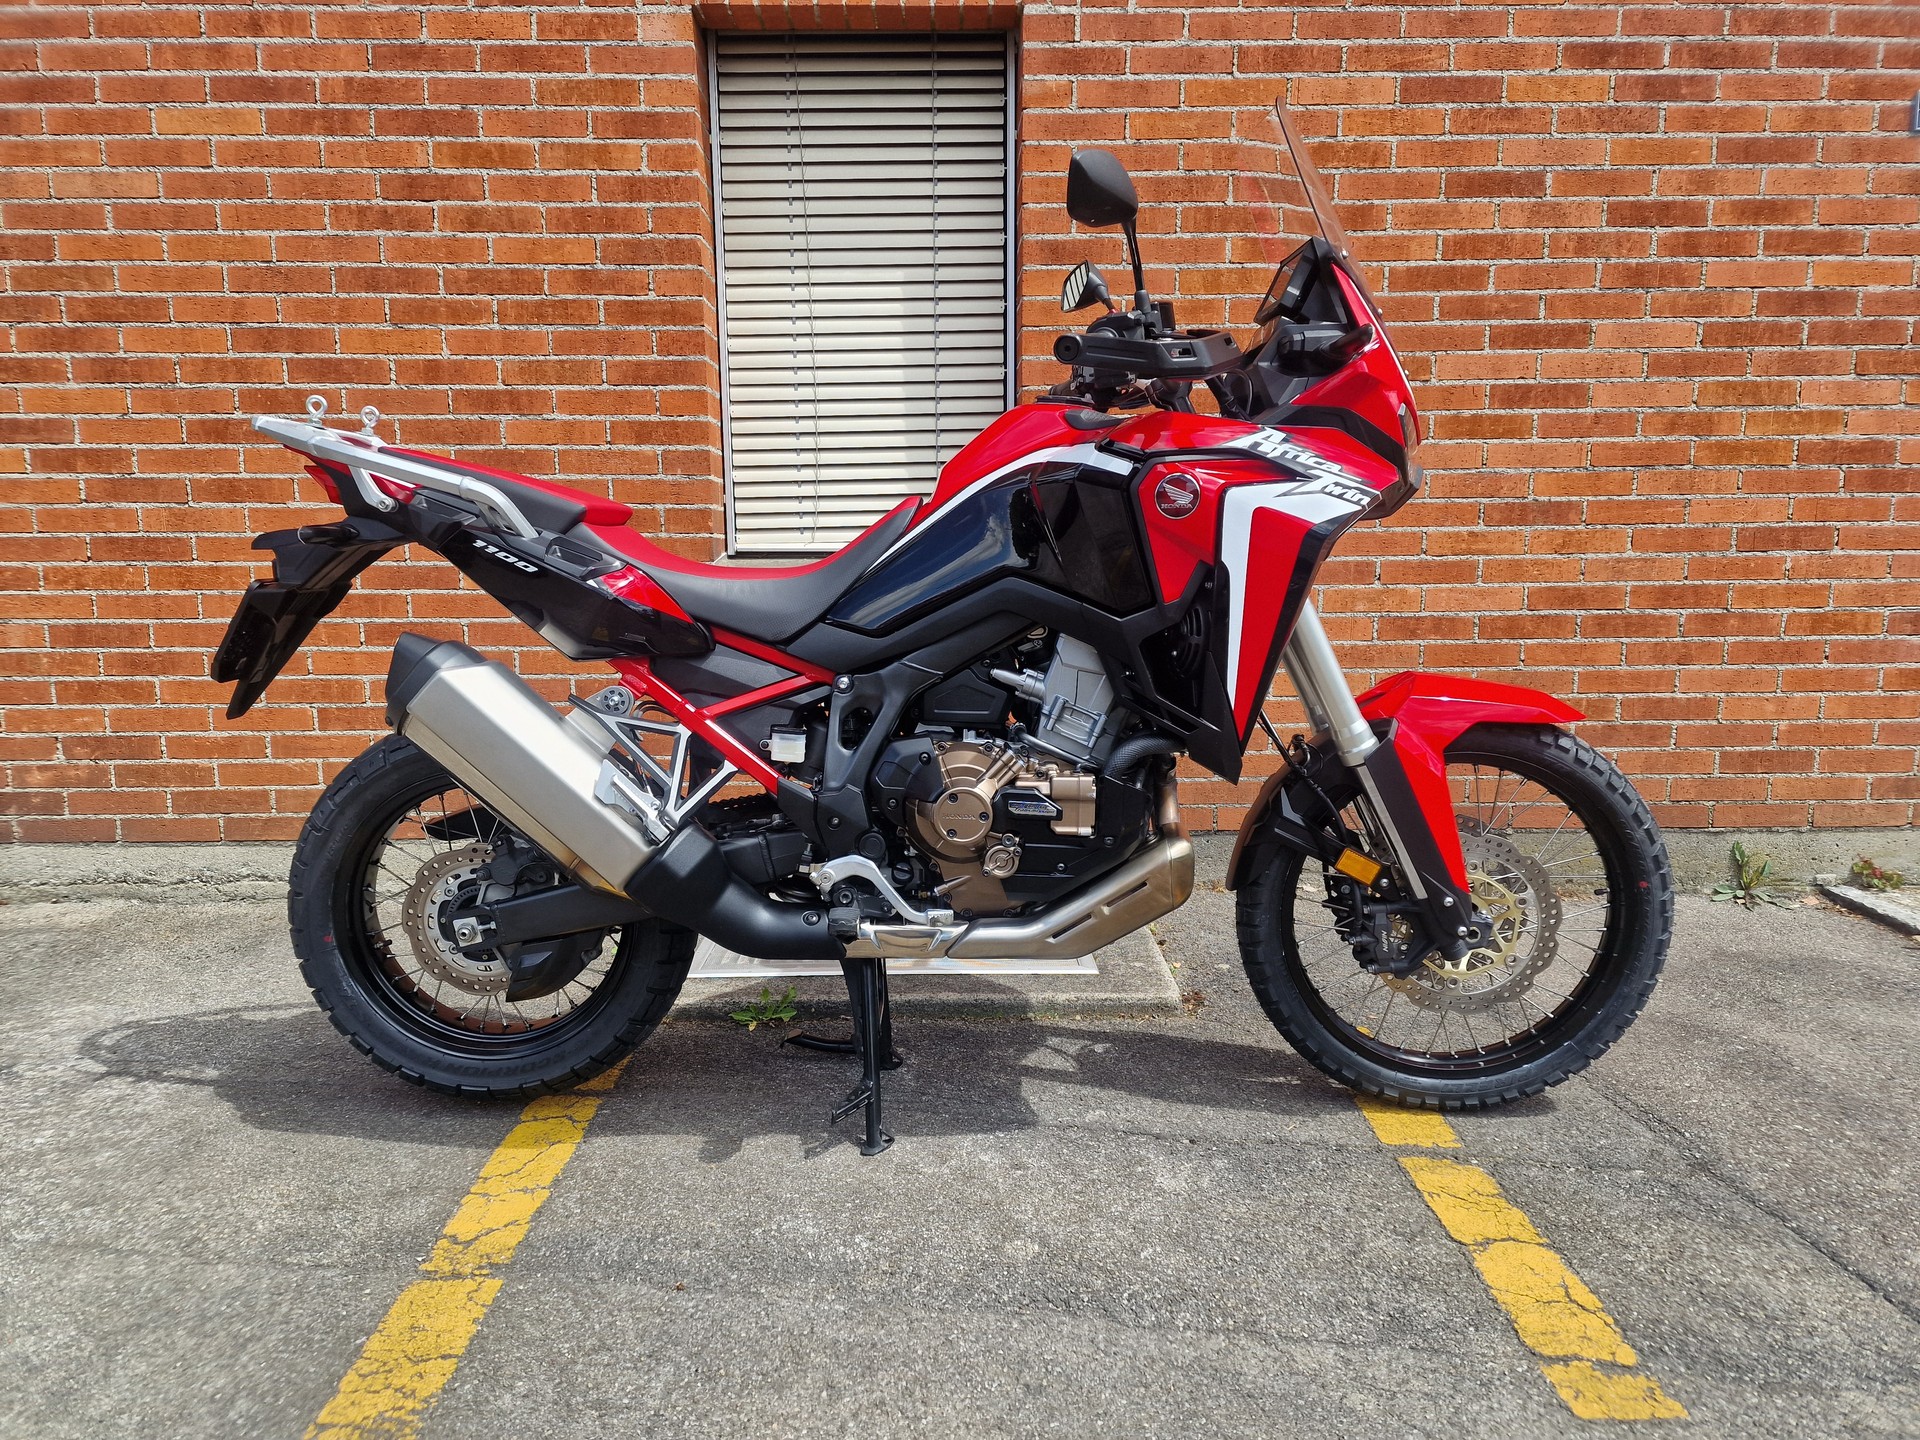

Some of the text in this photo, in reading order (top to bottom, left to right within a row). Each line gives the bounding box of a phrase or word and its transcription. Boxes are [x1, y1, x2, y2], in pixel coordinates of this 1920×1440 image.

[1222, 427, 1345, 473] Africa
[1290, 469, 1380, 505] Twin
[472, 539, 539, 573] 1100
